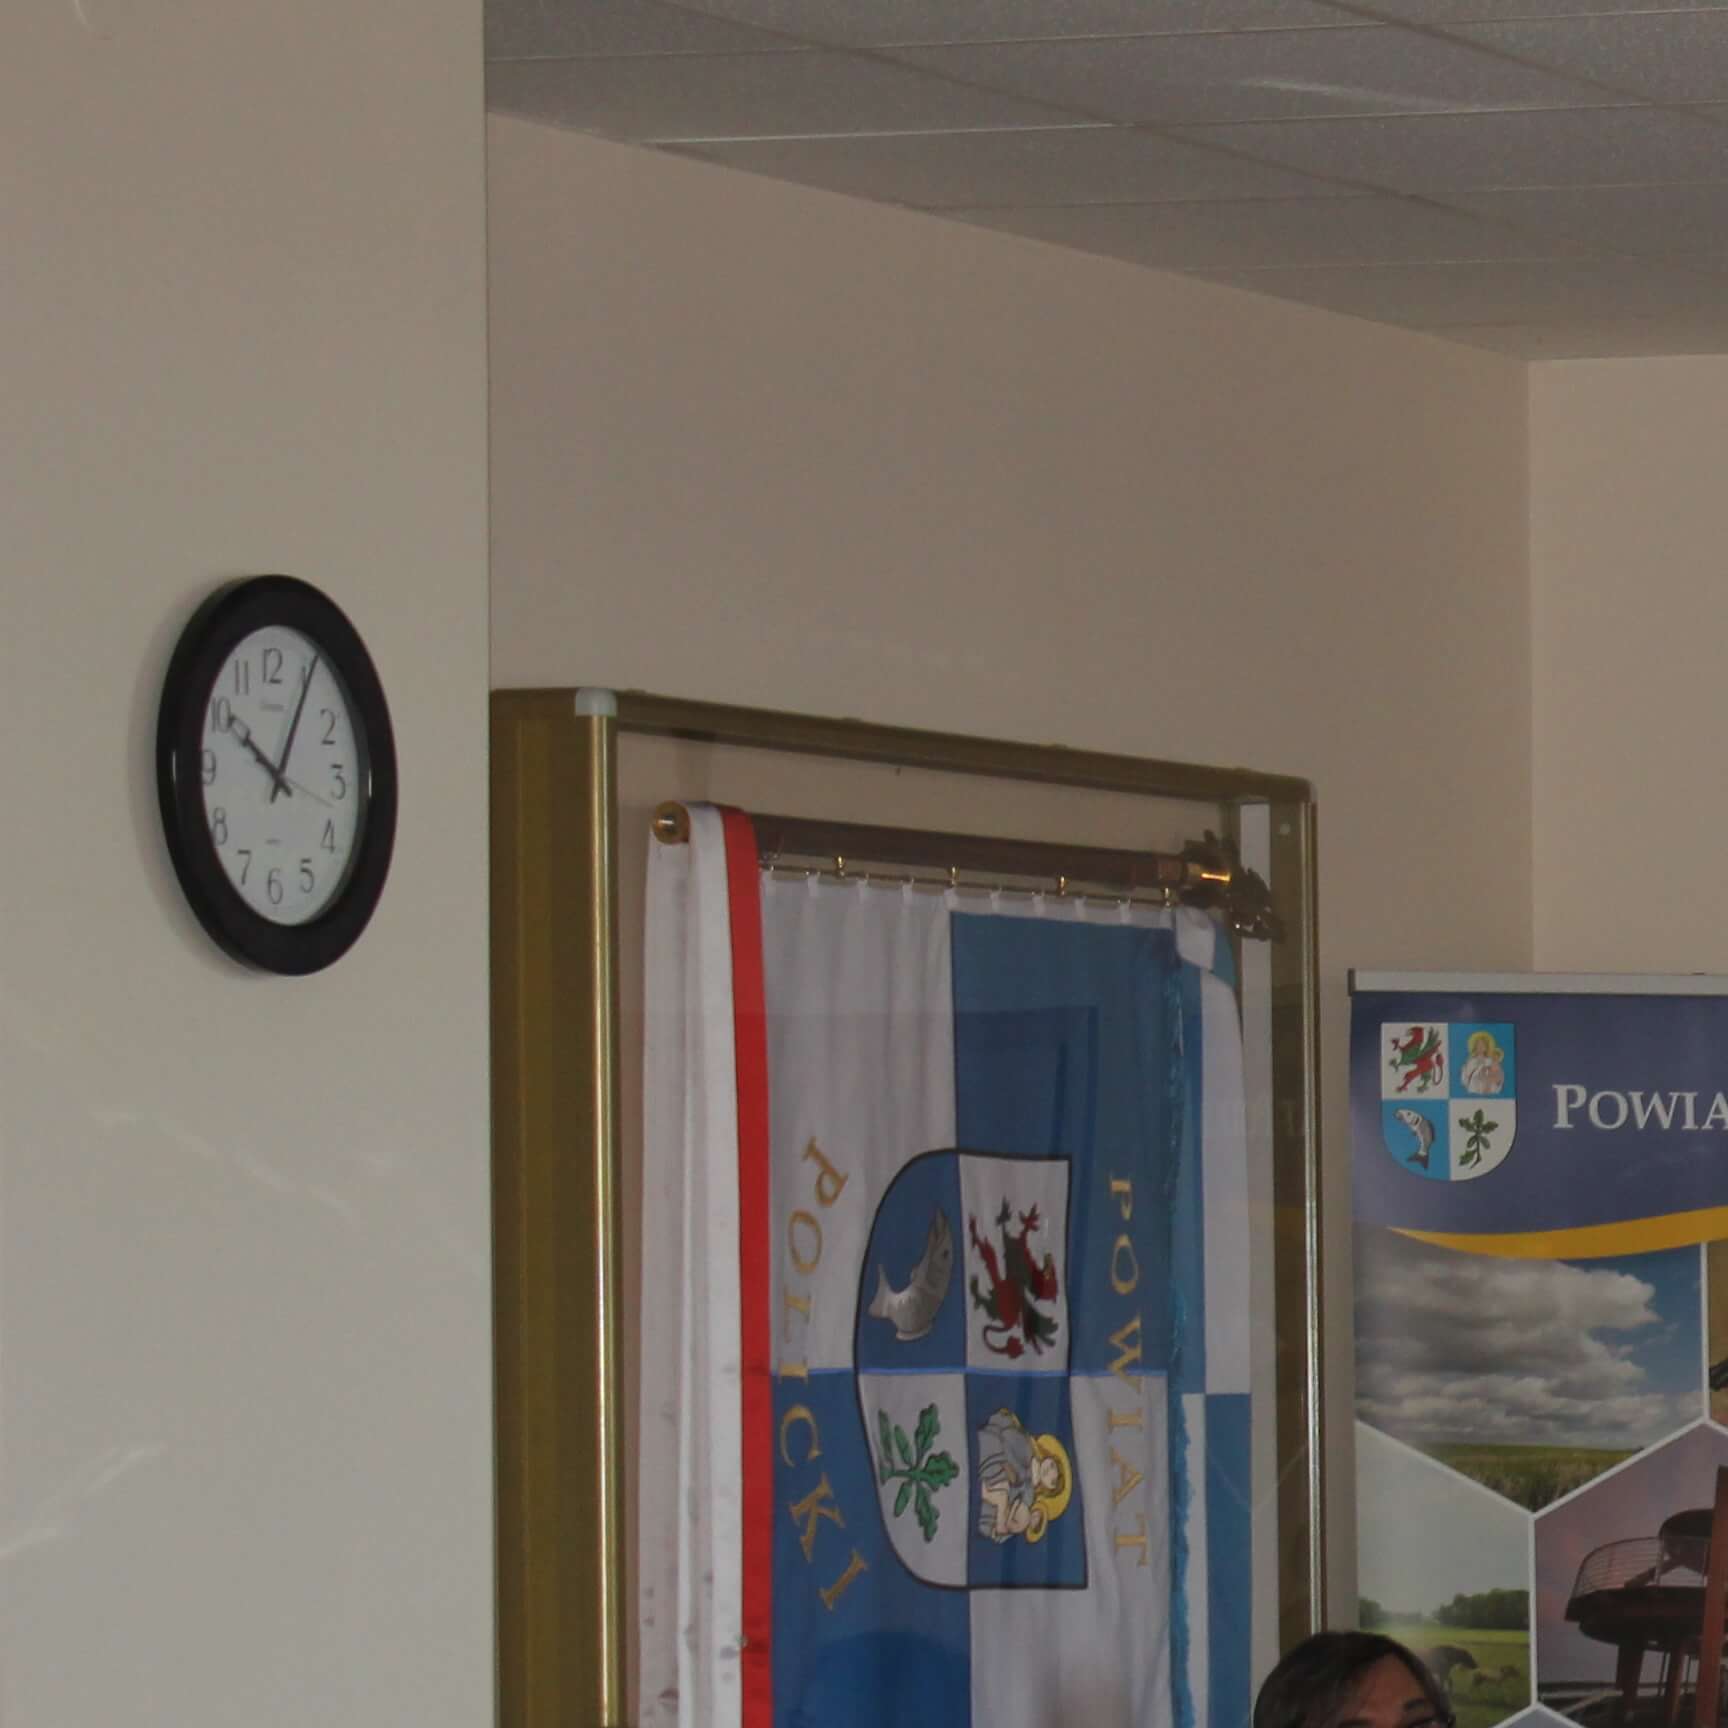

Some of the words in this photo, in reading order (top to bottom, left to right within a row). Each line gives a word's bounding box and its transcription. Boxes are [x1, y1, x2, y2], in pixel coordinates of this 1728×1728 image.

[234, 659, 249, 696] 11
[262, 647, 282, 684] 12
[211, 696, 232, 734] 10
[320, 708, 336, 745] 2
[201, 750, 216, 785] 9
[330, 763, 346, 800] 3
[212, 807, 228, 845] 8
[320, 819, 336, 854] 4
[237, 849, 251, 885] 7
[300, 858, 314, 893] 5
[267, 868, 283, 904] 6
[778, 1136, 869, 1611] POLICKI
[1106, 1175, 1153, 1567] POWIAT
